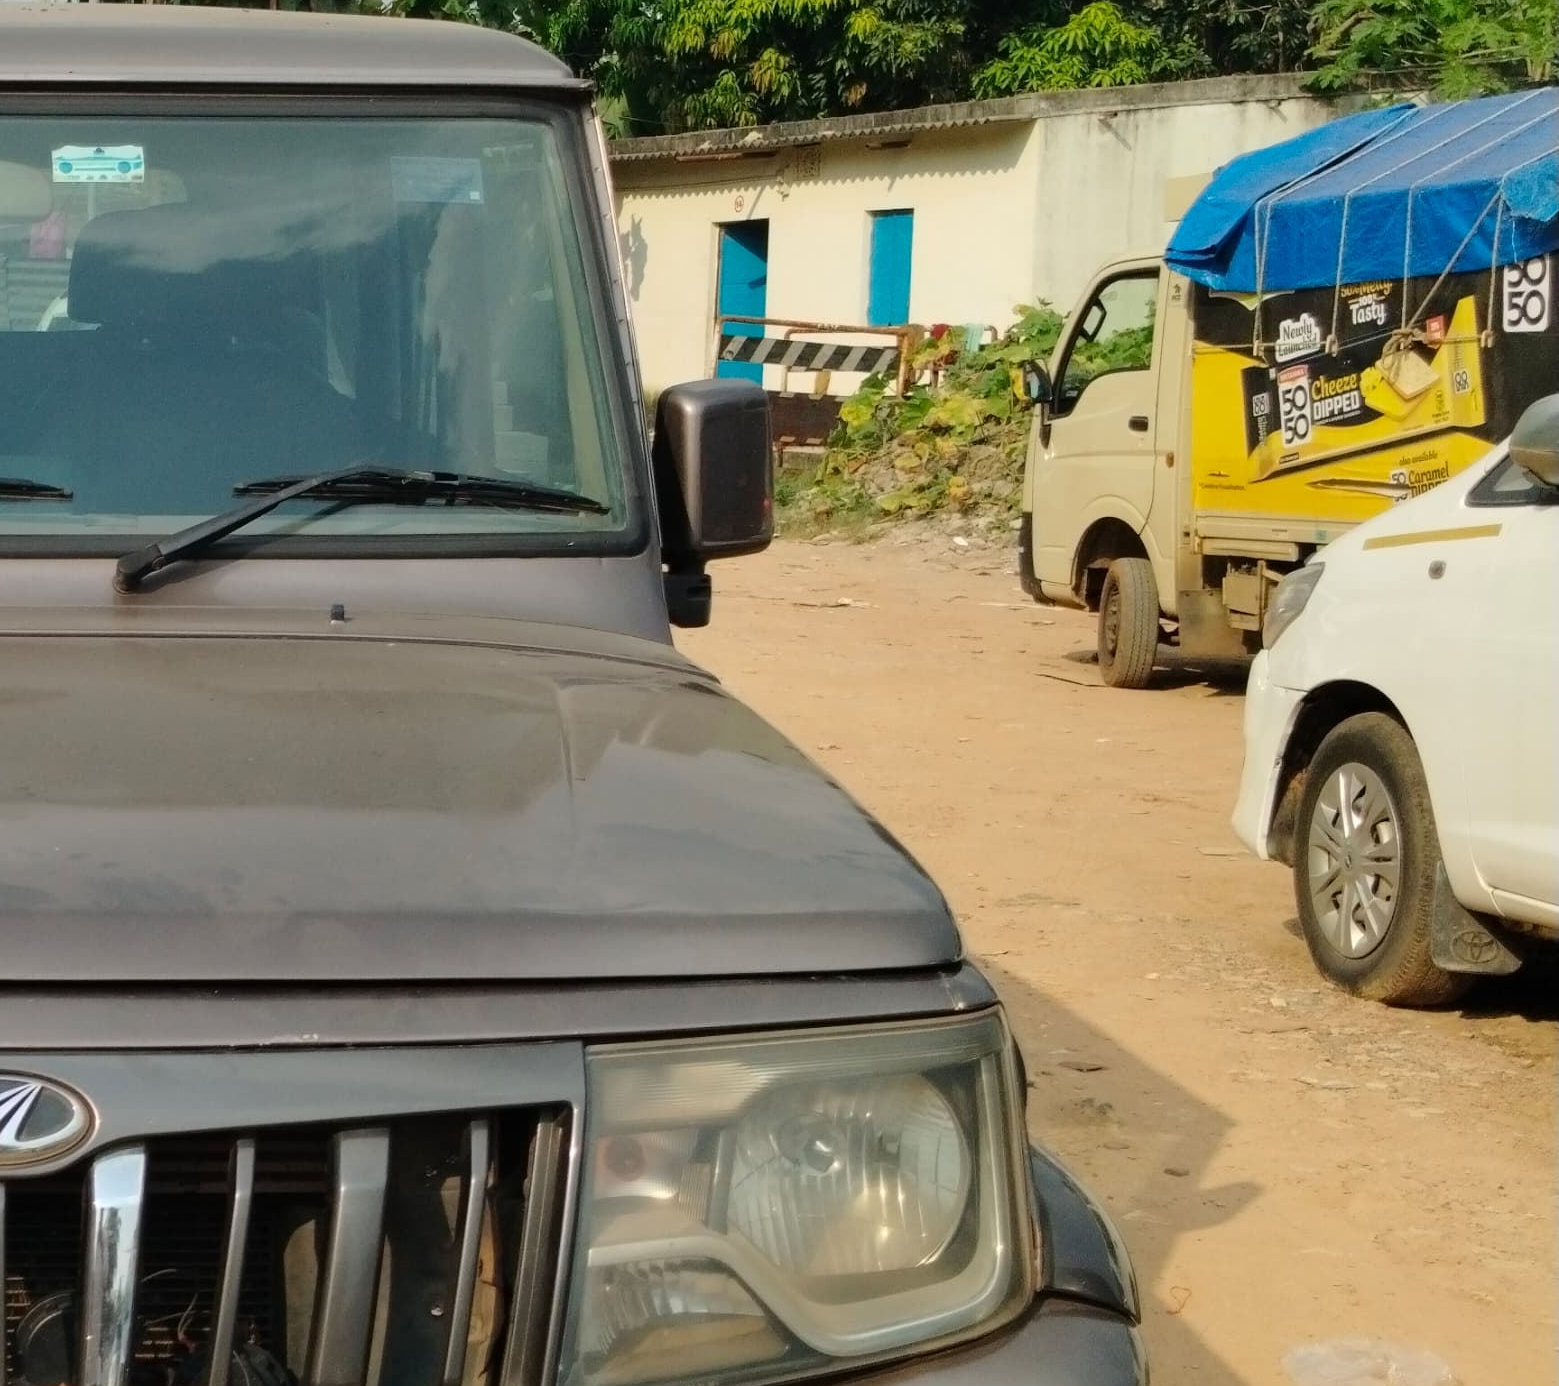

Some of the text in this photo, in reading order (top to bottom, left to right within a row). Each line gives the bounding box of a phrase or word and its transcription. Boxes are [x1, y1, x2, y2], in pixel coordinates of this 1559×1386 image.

[1508, 290, 1546, 327] 50
[1283, 319, 1312, 341] Newly
[1282, 385, 1307, 416] 50
[1311, 374, 1358, 401] Cheeze
[1313, 390, 1360, 421] DIPPED
[1284, 413, 1309, 444] 50
[1408, 460, 1449, 485] Caramel
[1410, 479, 1448, 498] DIPP
